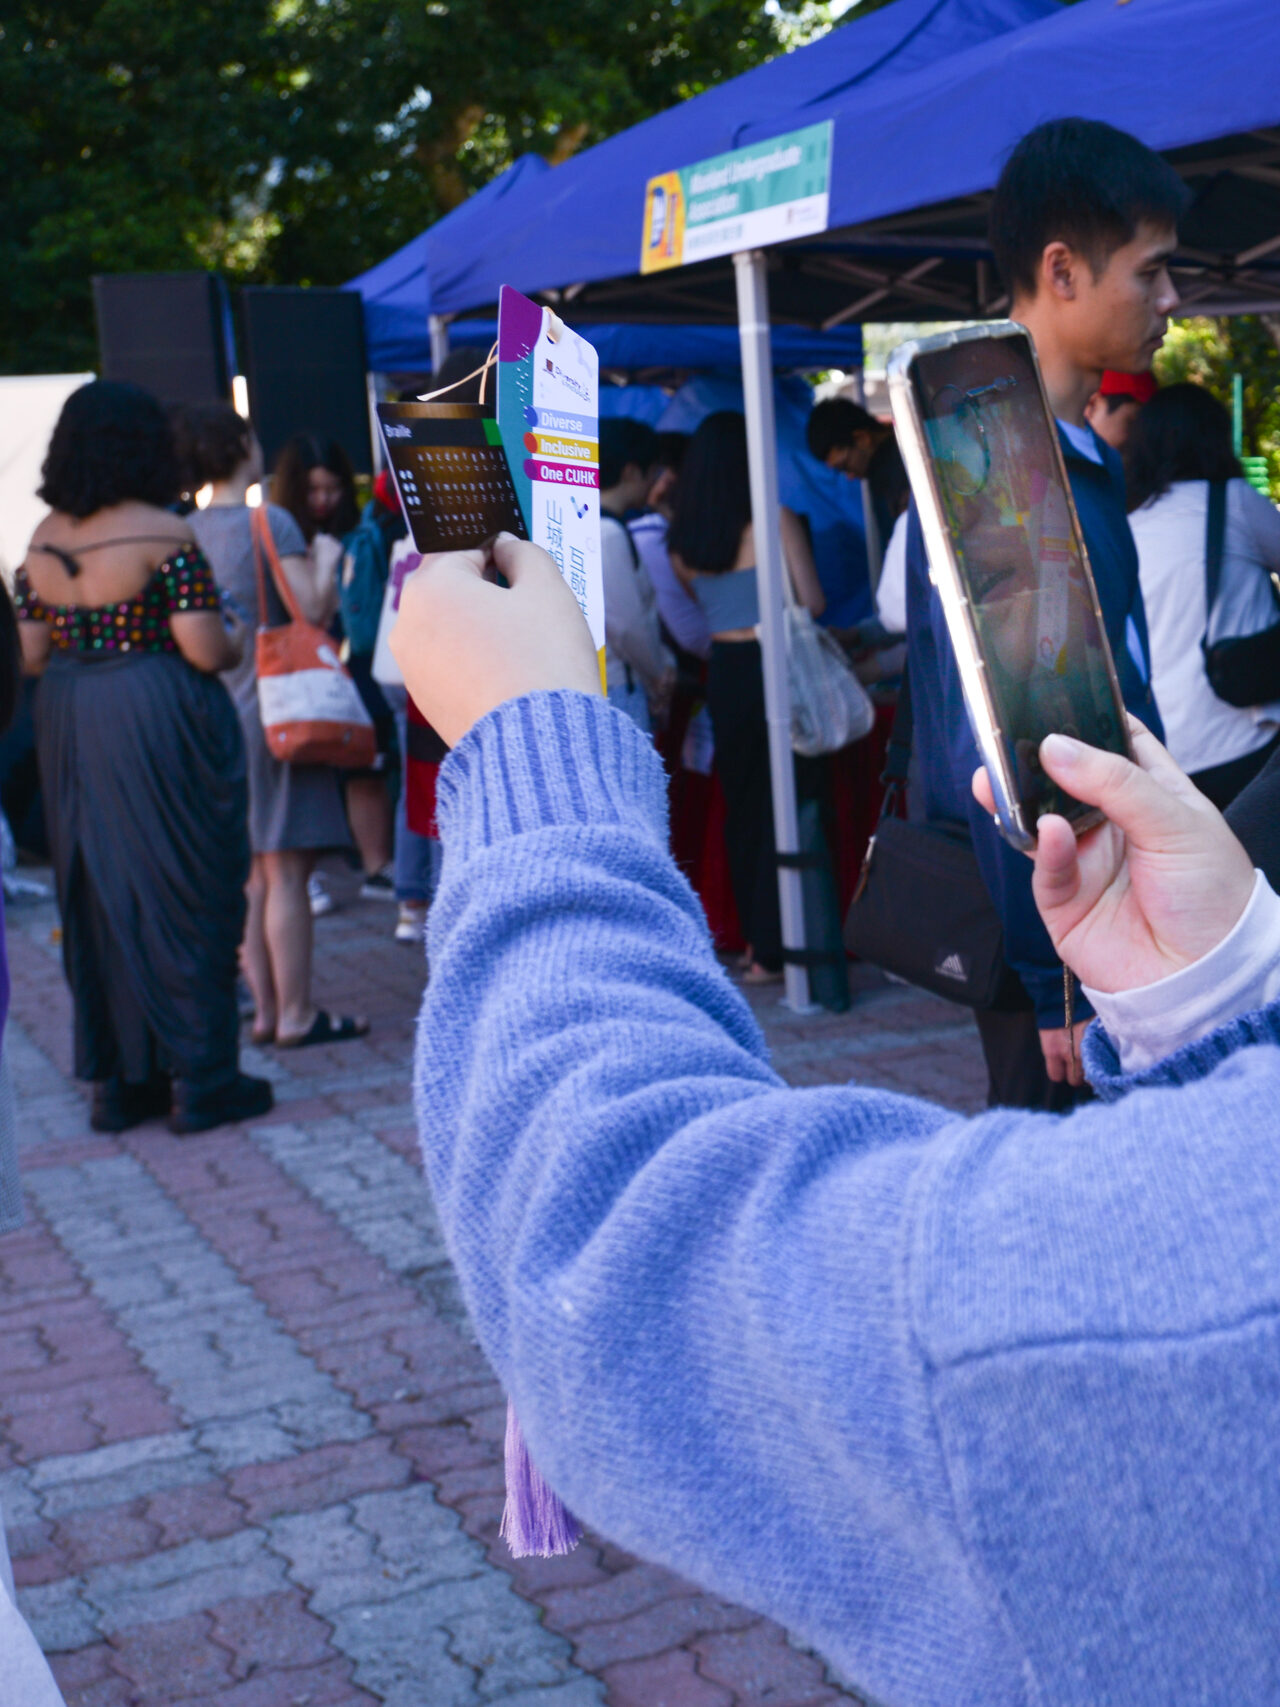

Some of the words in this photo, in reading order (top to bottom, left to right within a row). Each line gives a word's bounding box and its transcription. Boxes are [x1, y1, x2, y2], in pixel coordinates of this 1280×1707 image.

[541, 412, 583, 432] Diverse
[541, 438, 591, 459] Inclusive
[541, 465, 564, 481] One
[565, 468, 596, 486] CUHK
